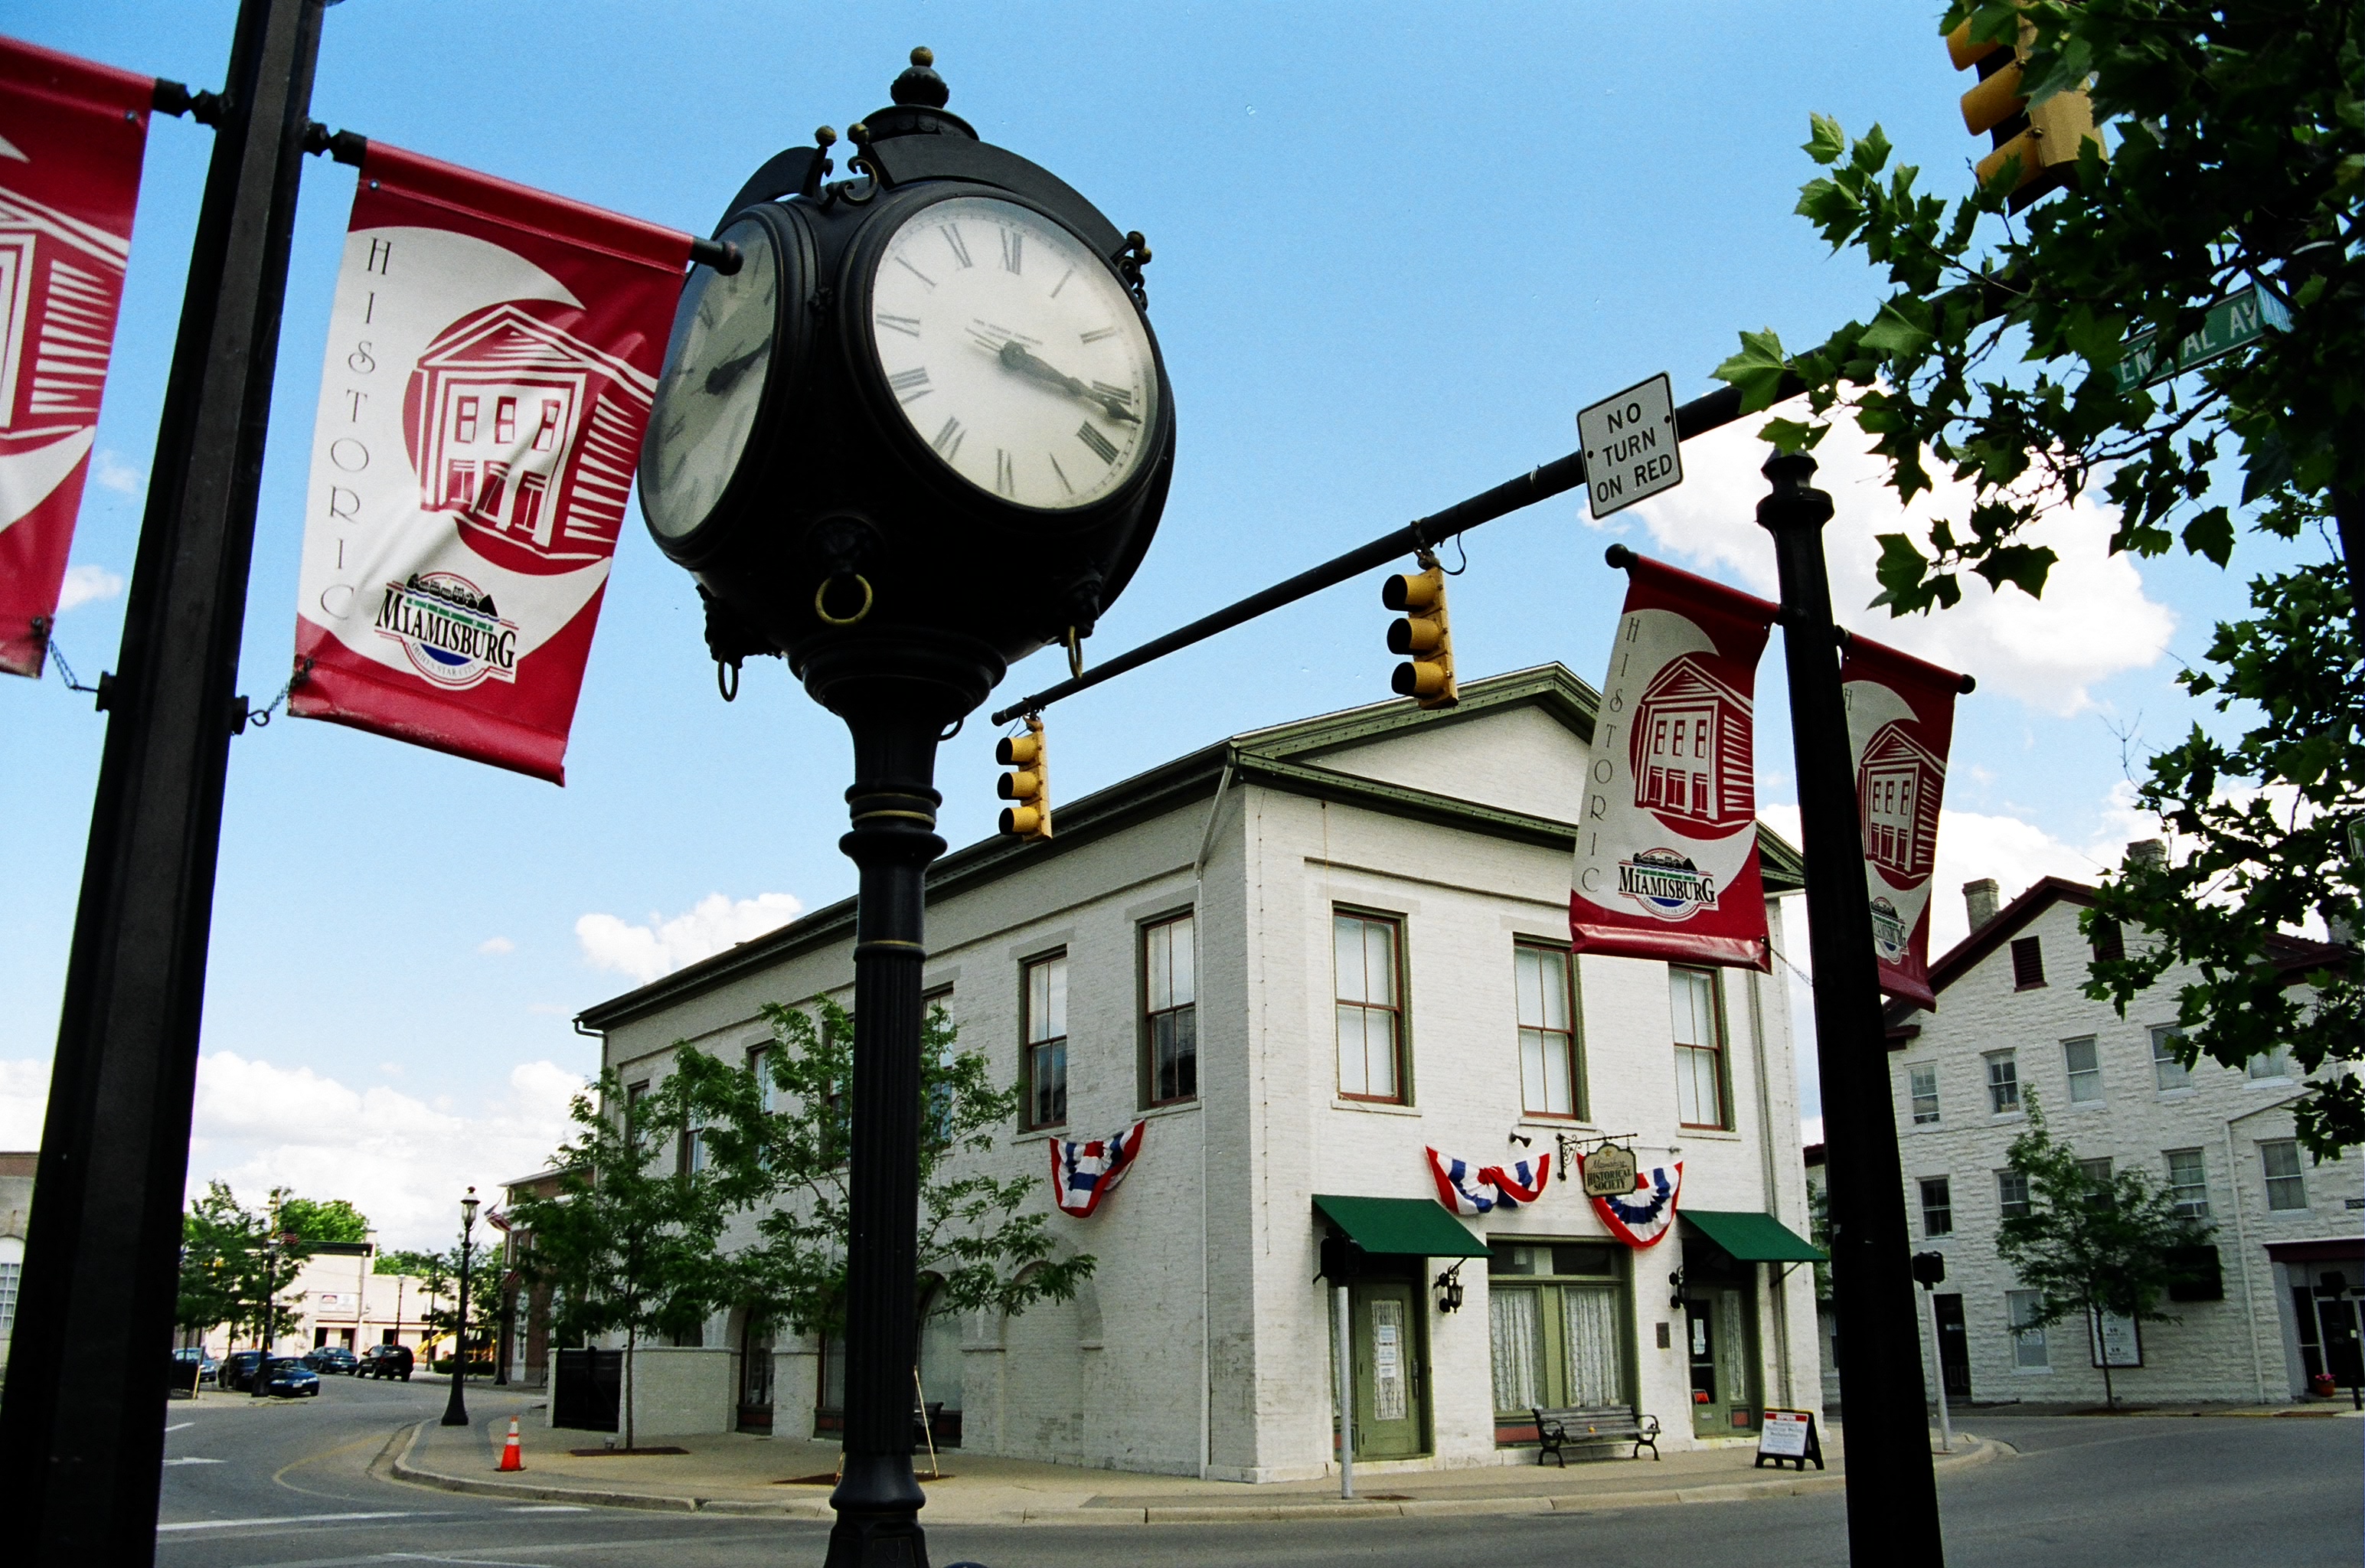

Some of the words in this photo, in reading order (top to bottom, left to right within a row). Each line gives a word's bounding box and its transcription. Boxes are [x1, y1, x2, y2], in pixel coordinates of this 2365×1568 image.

[2119, 328, 2216, 384] ENAL
[319, 237, 392, 620] HISTORIC
[1607, 402, 1641, 434] NO
[1602, 426, 1657, 467] TURN
[1596, 474, 1623, 503] ON
[1634, 453, 1673, 488] RED
[374, 588, 517, 669] MIAMISBURG
[1582, 617, 1640, 893] HISTORIC
[1618, 865, 1716, 903] MIAMISBURG
[1586, 1169, 1632, 1187] HISTORICAL
[1593, 1178, 1625, 1191] SOCIETY
